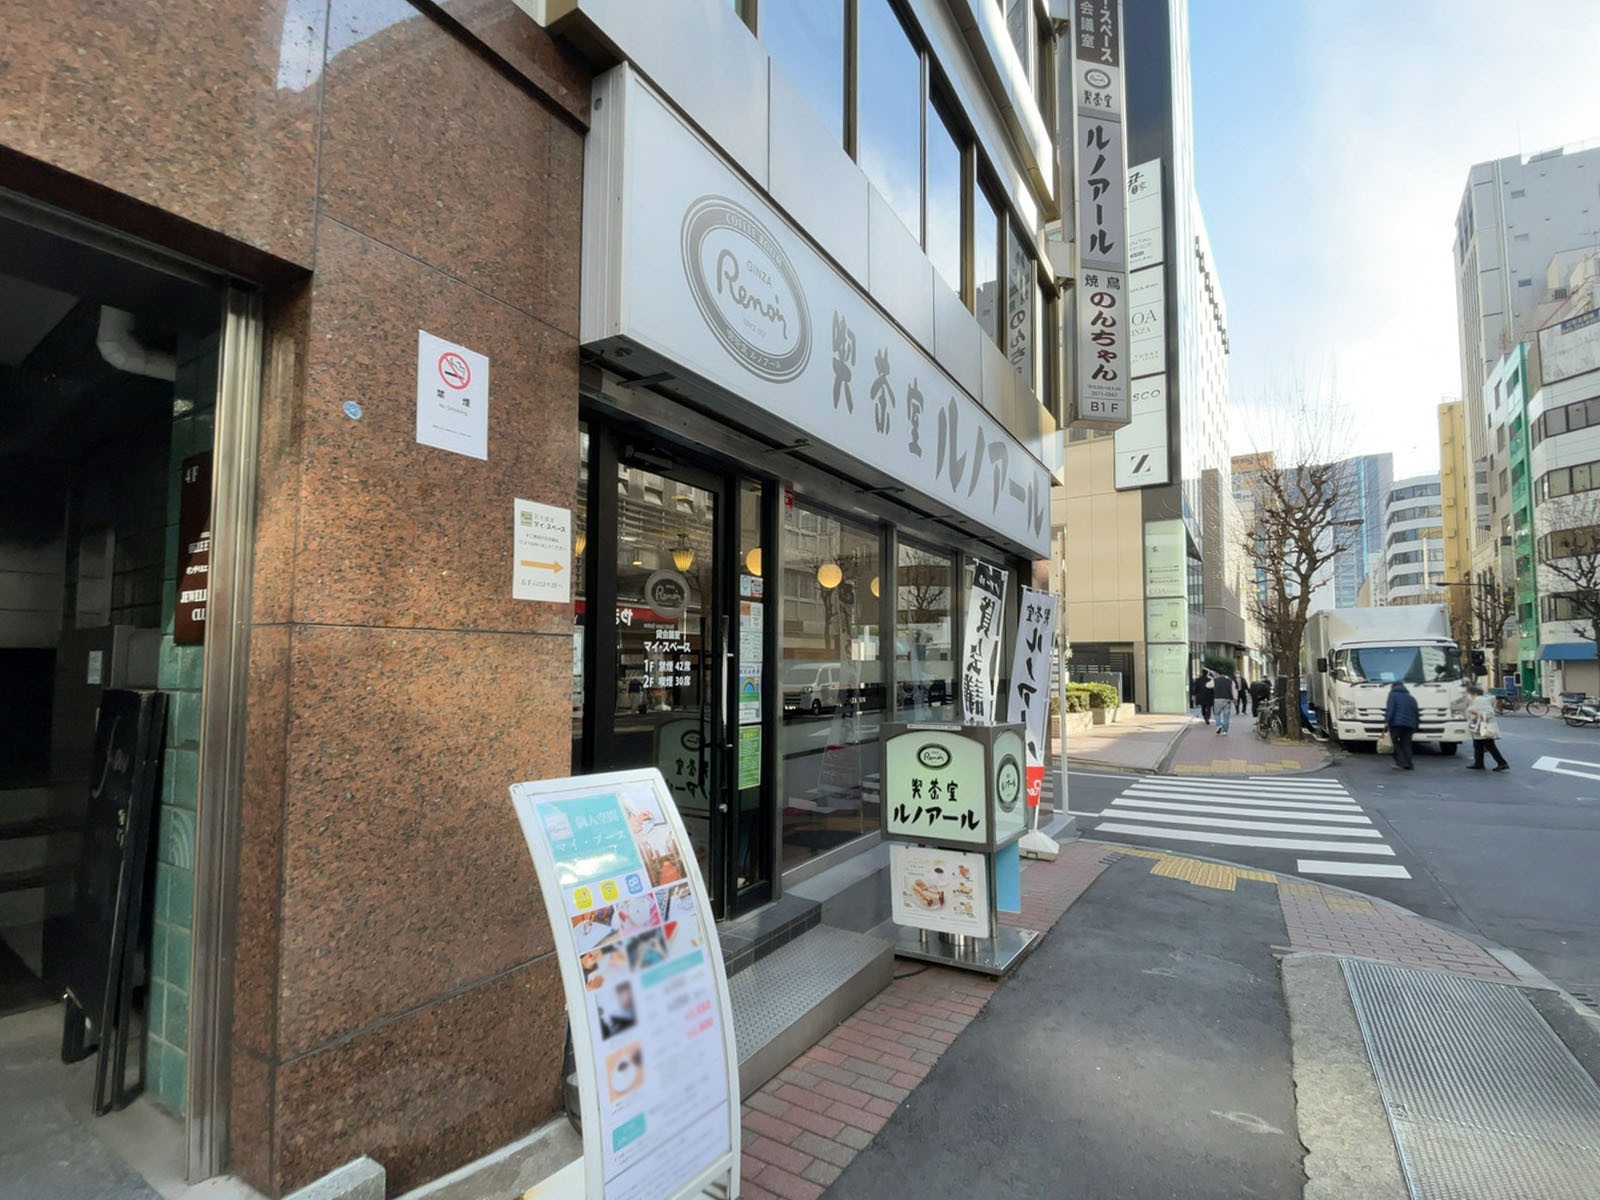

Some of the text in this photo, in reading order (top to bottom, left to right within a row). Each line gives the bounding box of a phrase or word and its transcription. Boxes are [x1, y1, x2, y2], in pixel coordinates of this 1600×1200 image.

[1086, 125, 1114, 255] ルノアール
[746, 260, 772, 287] GINZA
[717, 249, 787, 340] Renoir
[1131, 309, 1157, 326] OA
[1090, 292, 1117, 382] のんちゃん
[1132, 389, 1160, 402] SCO
[833, 310, 1044, 540] 喫茶室 ルノアール
[643, 641, 691, 653] マイ・スペース
[643, 659, 655, 673] 1F
[642, 674, 655, 689] 2F
[911, 778, 959, 802] 喫茶室
[893, 803, 981, 831] ルノアール
